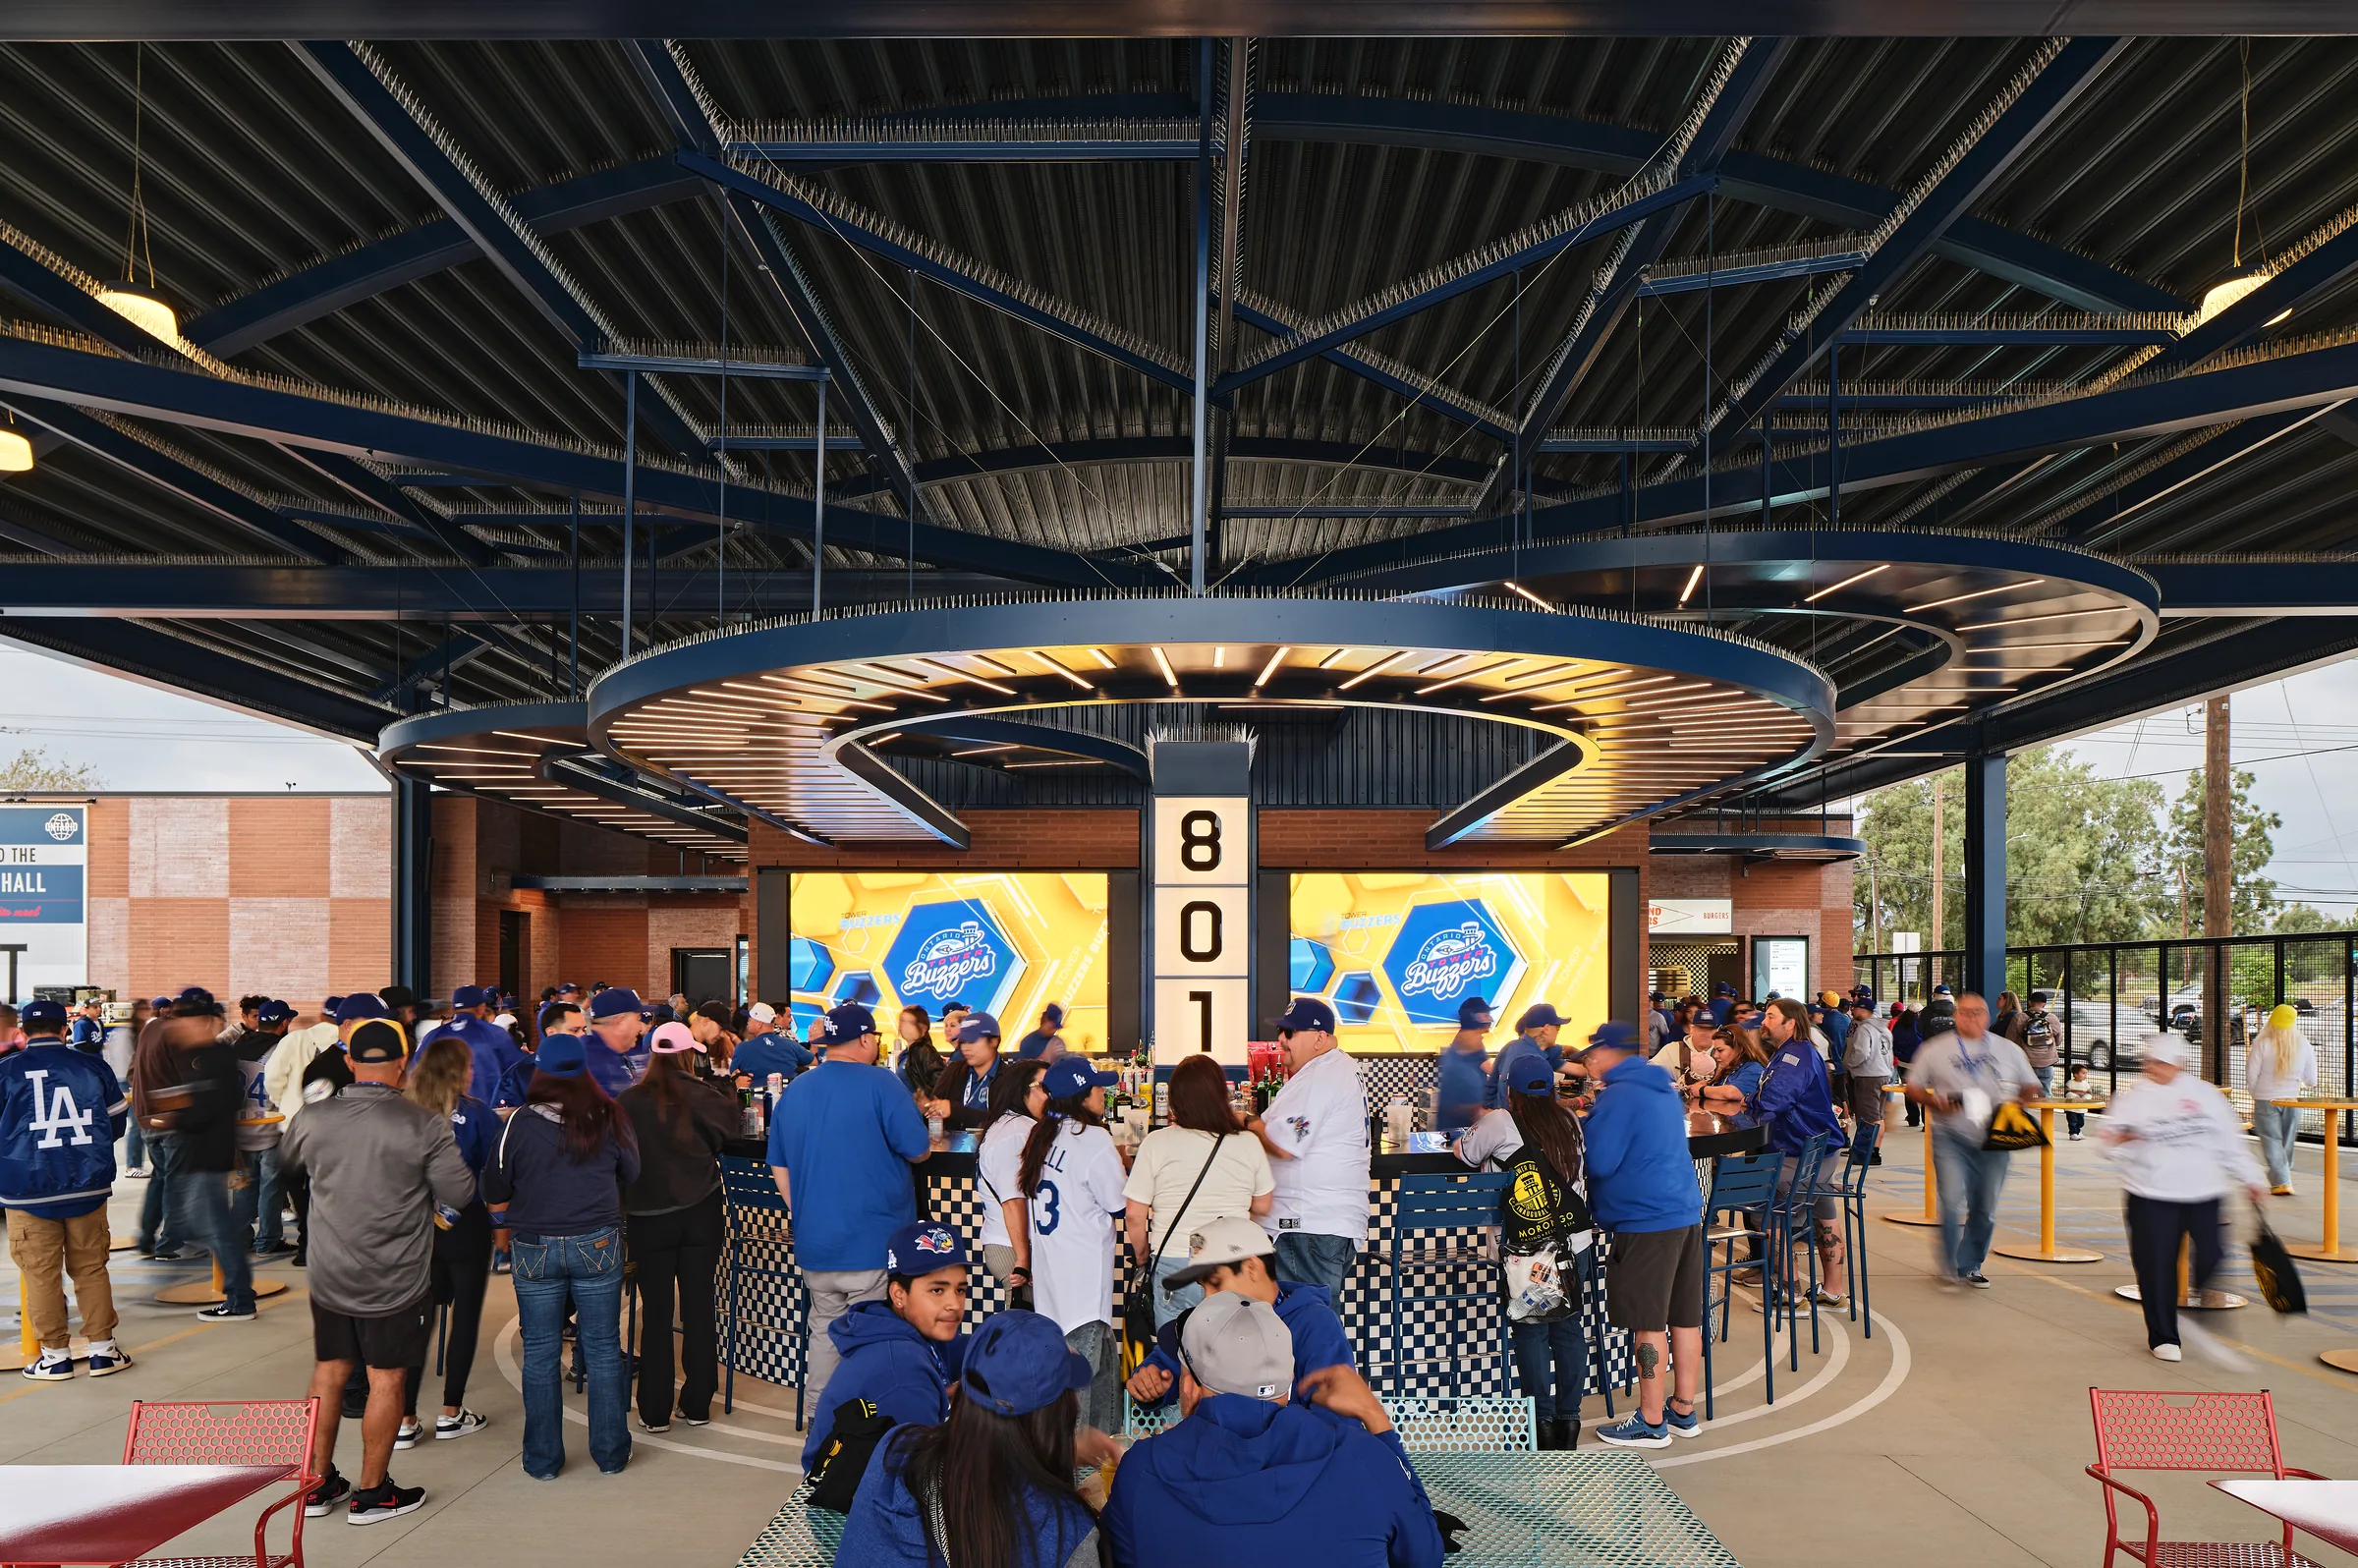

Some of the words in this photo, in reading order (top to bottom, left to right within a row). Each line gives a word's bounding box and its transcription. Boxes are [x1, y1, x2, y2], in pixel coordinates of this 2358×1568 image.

[45, 822, 78, 832] ONTARIO
[12, 848, 36, 863] THE
[1, 872, 46, 893] HALL
[840, 911, 868, 920] TOWER
[840, 913, 901, 929] BUZZERS
[1340, 914, 1401, 930] BUZZERS
[1341, 911, 1368, 920] TOWER
[921, 932, 961, 960] ONTARIO
[1421, 932, 1461, 960] ONTARIO
[928, 948, 983, 968] TOWER
[1429, 949, 1485, 969] TOWER
[902, 954, 989, 995] Buzzers
[1059, 954, 1094, 1011] BUZZERS
[1403, 954, 1489, 995] Buzzers
[1072, 1073, 1087, 1088] LA
[25, 1070, 93, 1149] LA
